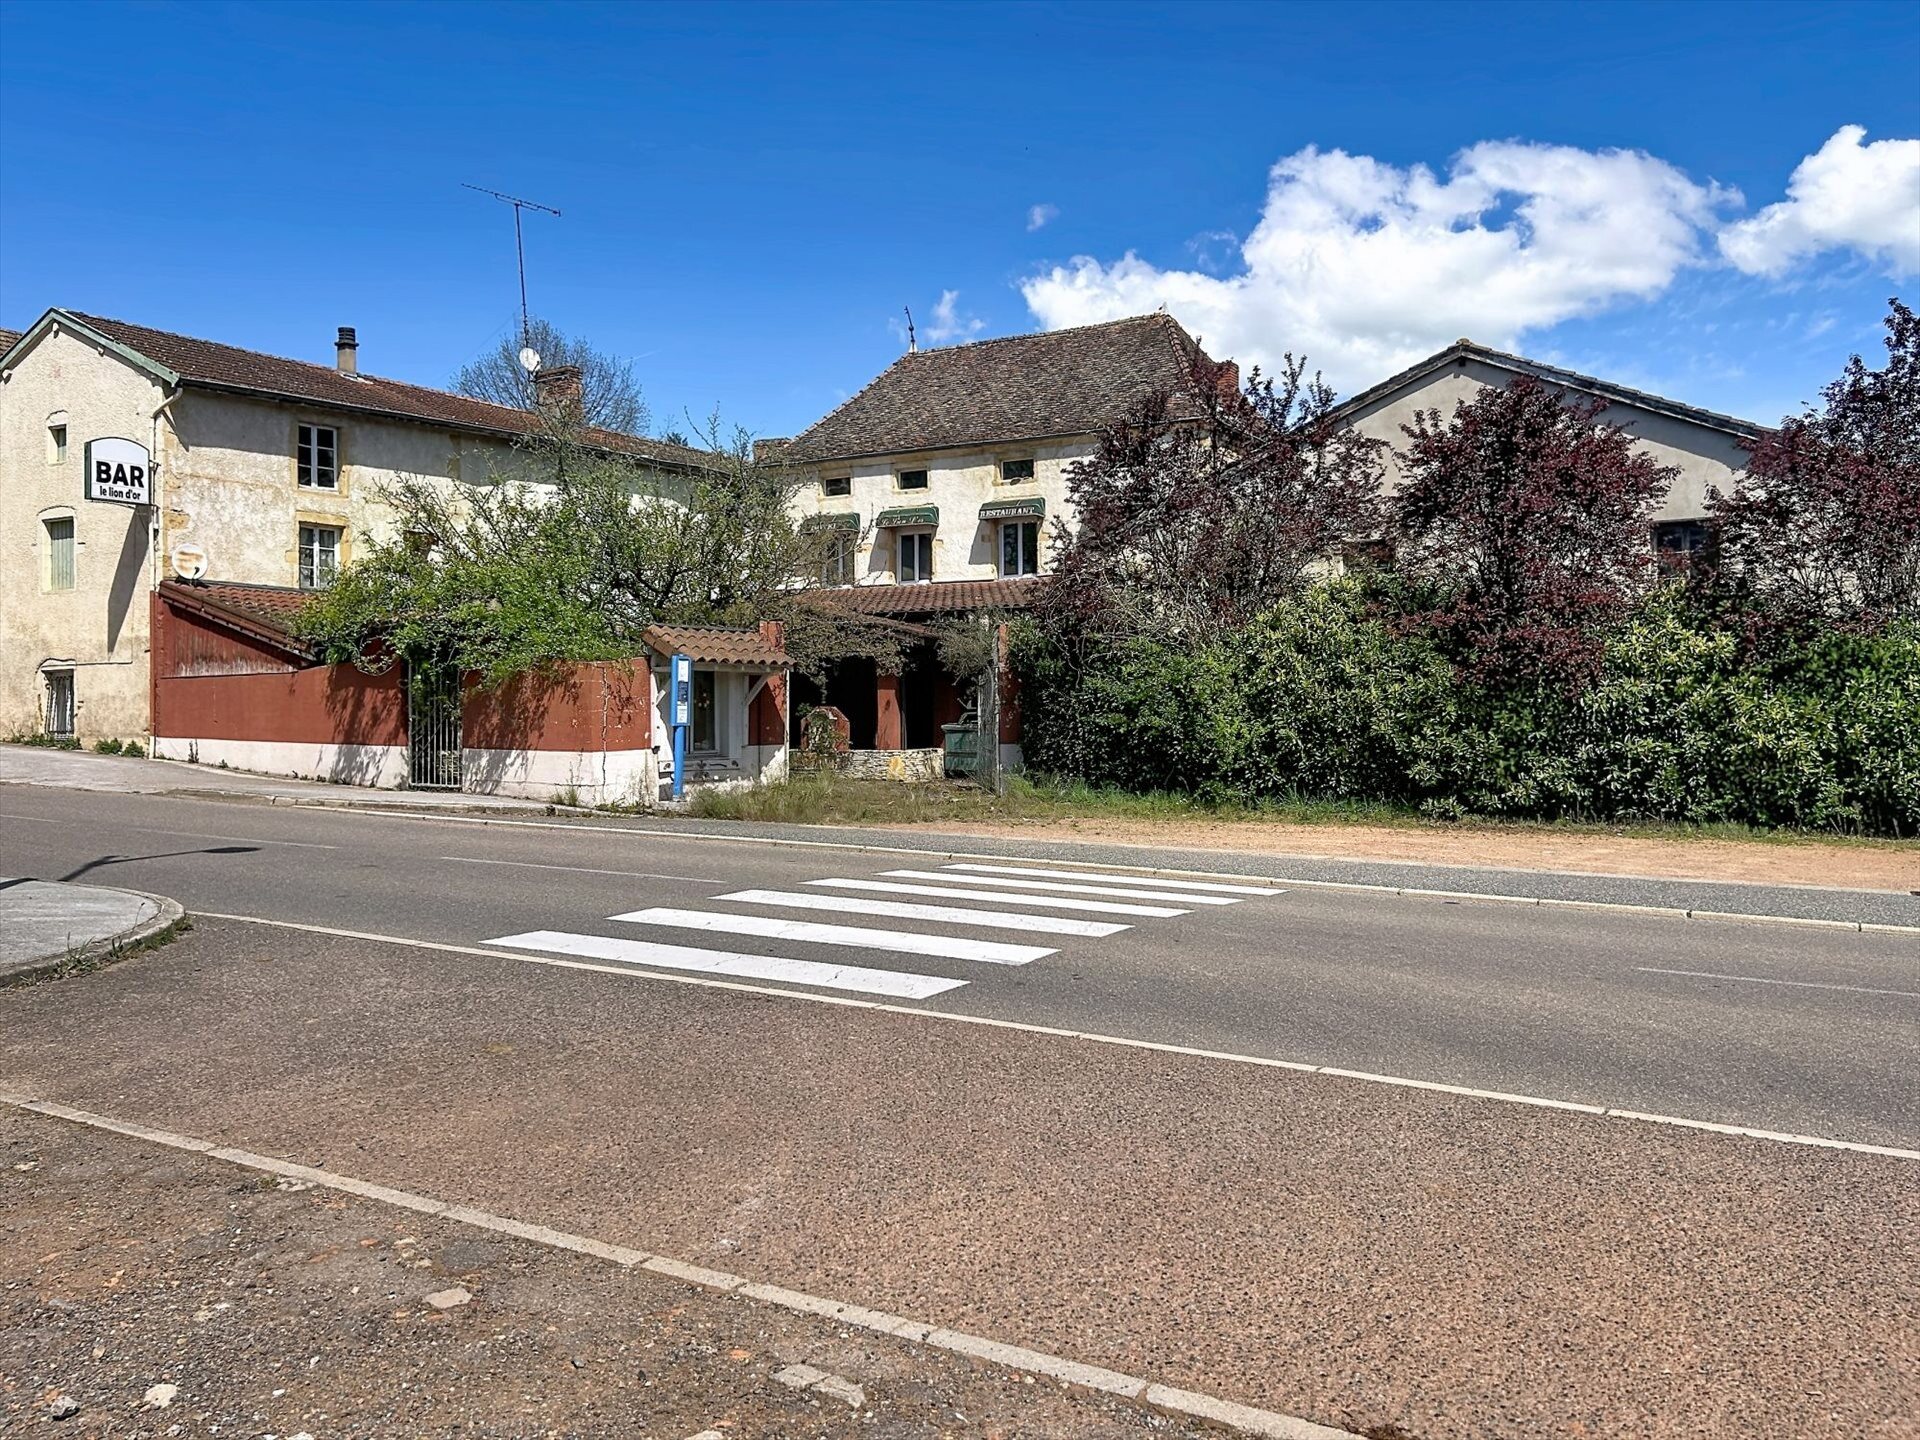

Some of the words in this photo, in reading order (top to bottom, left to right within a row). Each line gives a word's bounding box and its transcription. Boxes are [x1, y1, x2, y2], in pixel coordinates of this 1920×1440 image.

[96, 461, 144, 488] BAR
[100, 486, 107, 496] le
[109, 487, 124, 498] lion
[125, 489, 141, 500] d'or
[980, 507, 1035, 518] RESTAURANT
